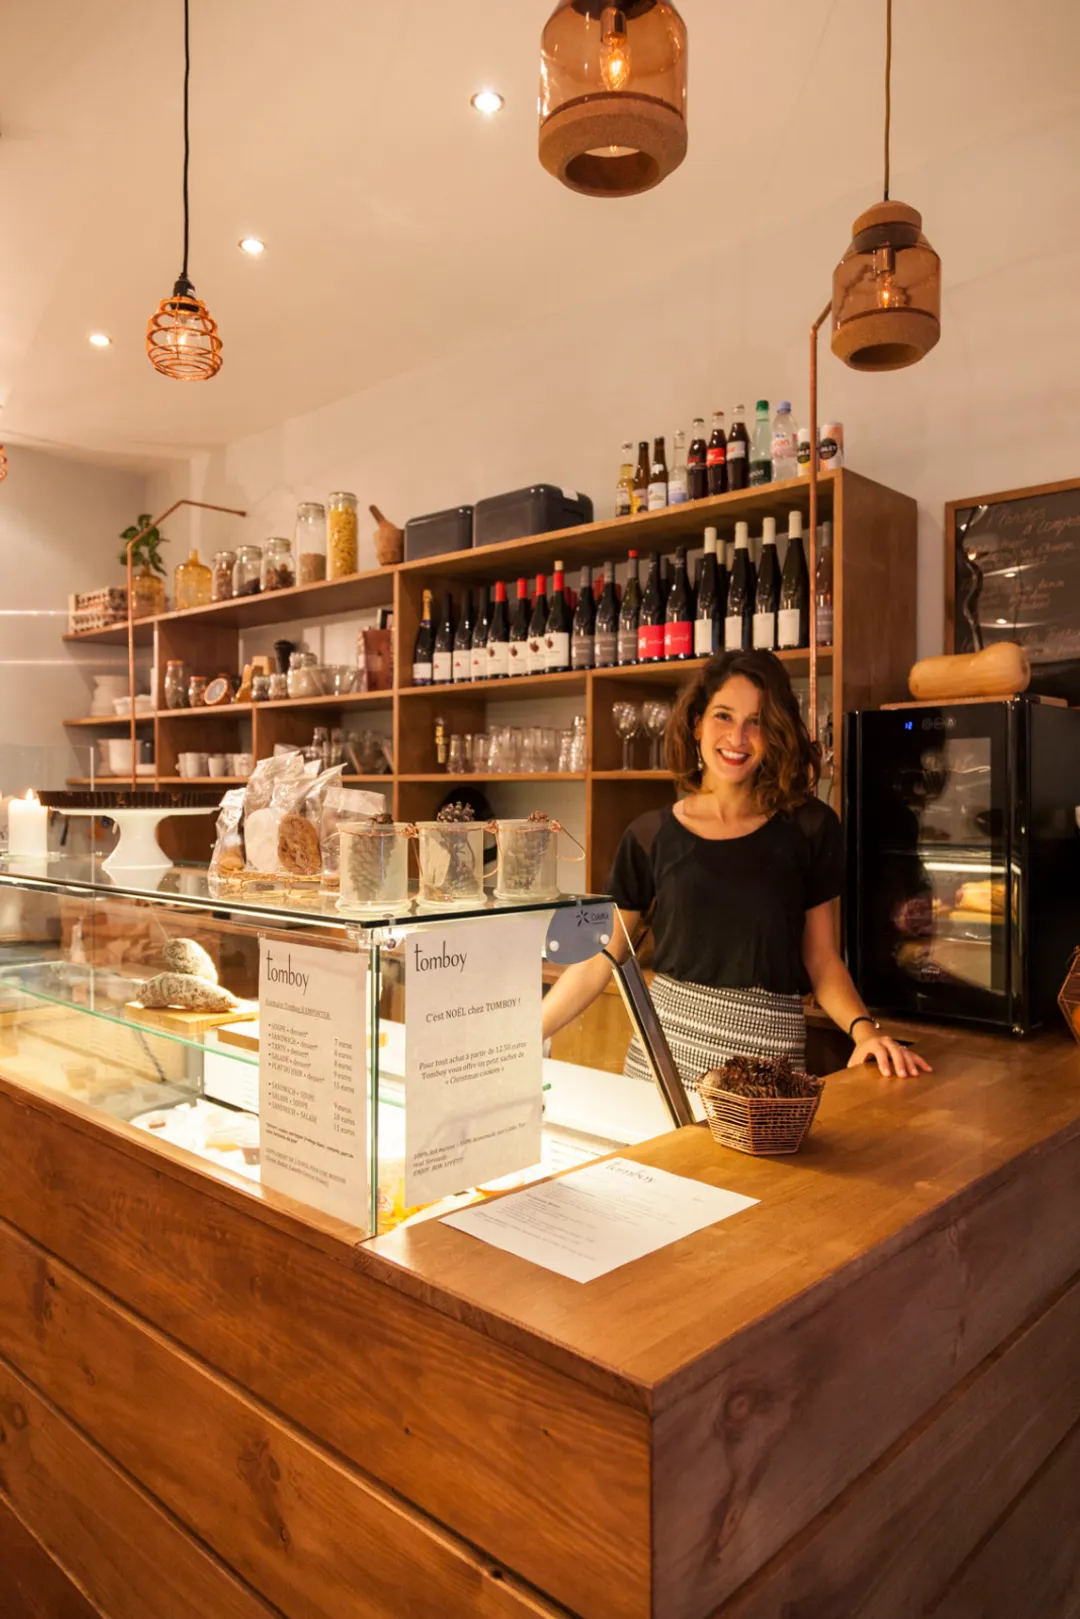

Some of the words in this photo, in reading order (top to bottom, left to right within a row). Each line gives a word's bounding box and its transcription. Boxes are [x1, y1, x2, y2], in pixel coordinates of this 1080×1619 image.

[414, 940, 468, 973] tomboy
[266, 949, 309, 996] tomboy
[426, 1011, 444, 1022] C'est
[467, 1005, 484, 1014] chez
[486, 998, 516, 1010] TOMBOY
[419, 1061, 434, 1070] Pour
[435, 1058, 448, 1066] tout
[449, 1054, 465, 1063] achat
[421, 1068, 447, 1080] Tomboy
[462, 1061, 477, 1070] offre
